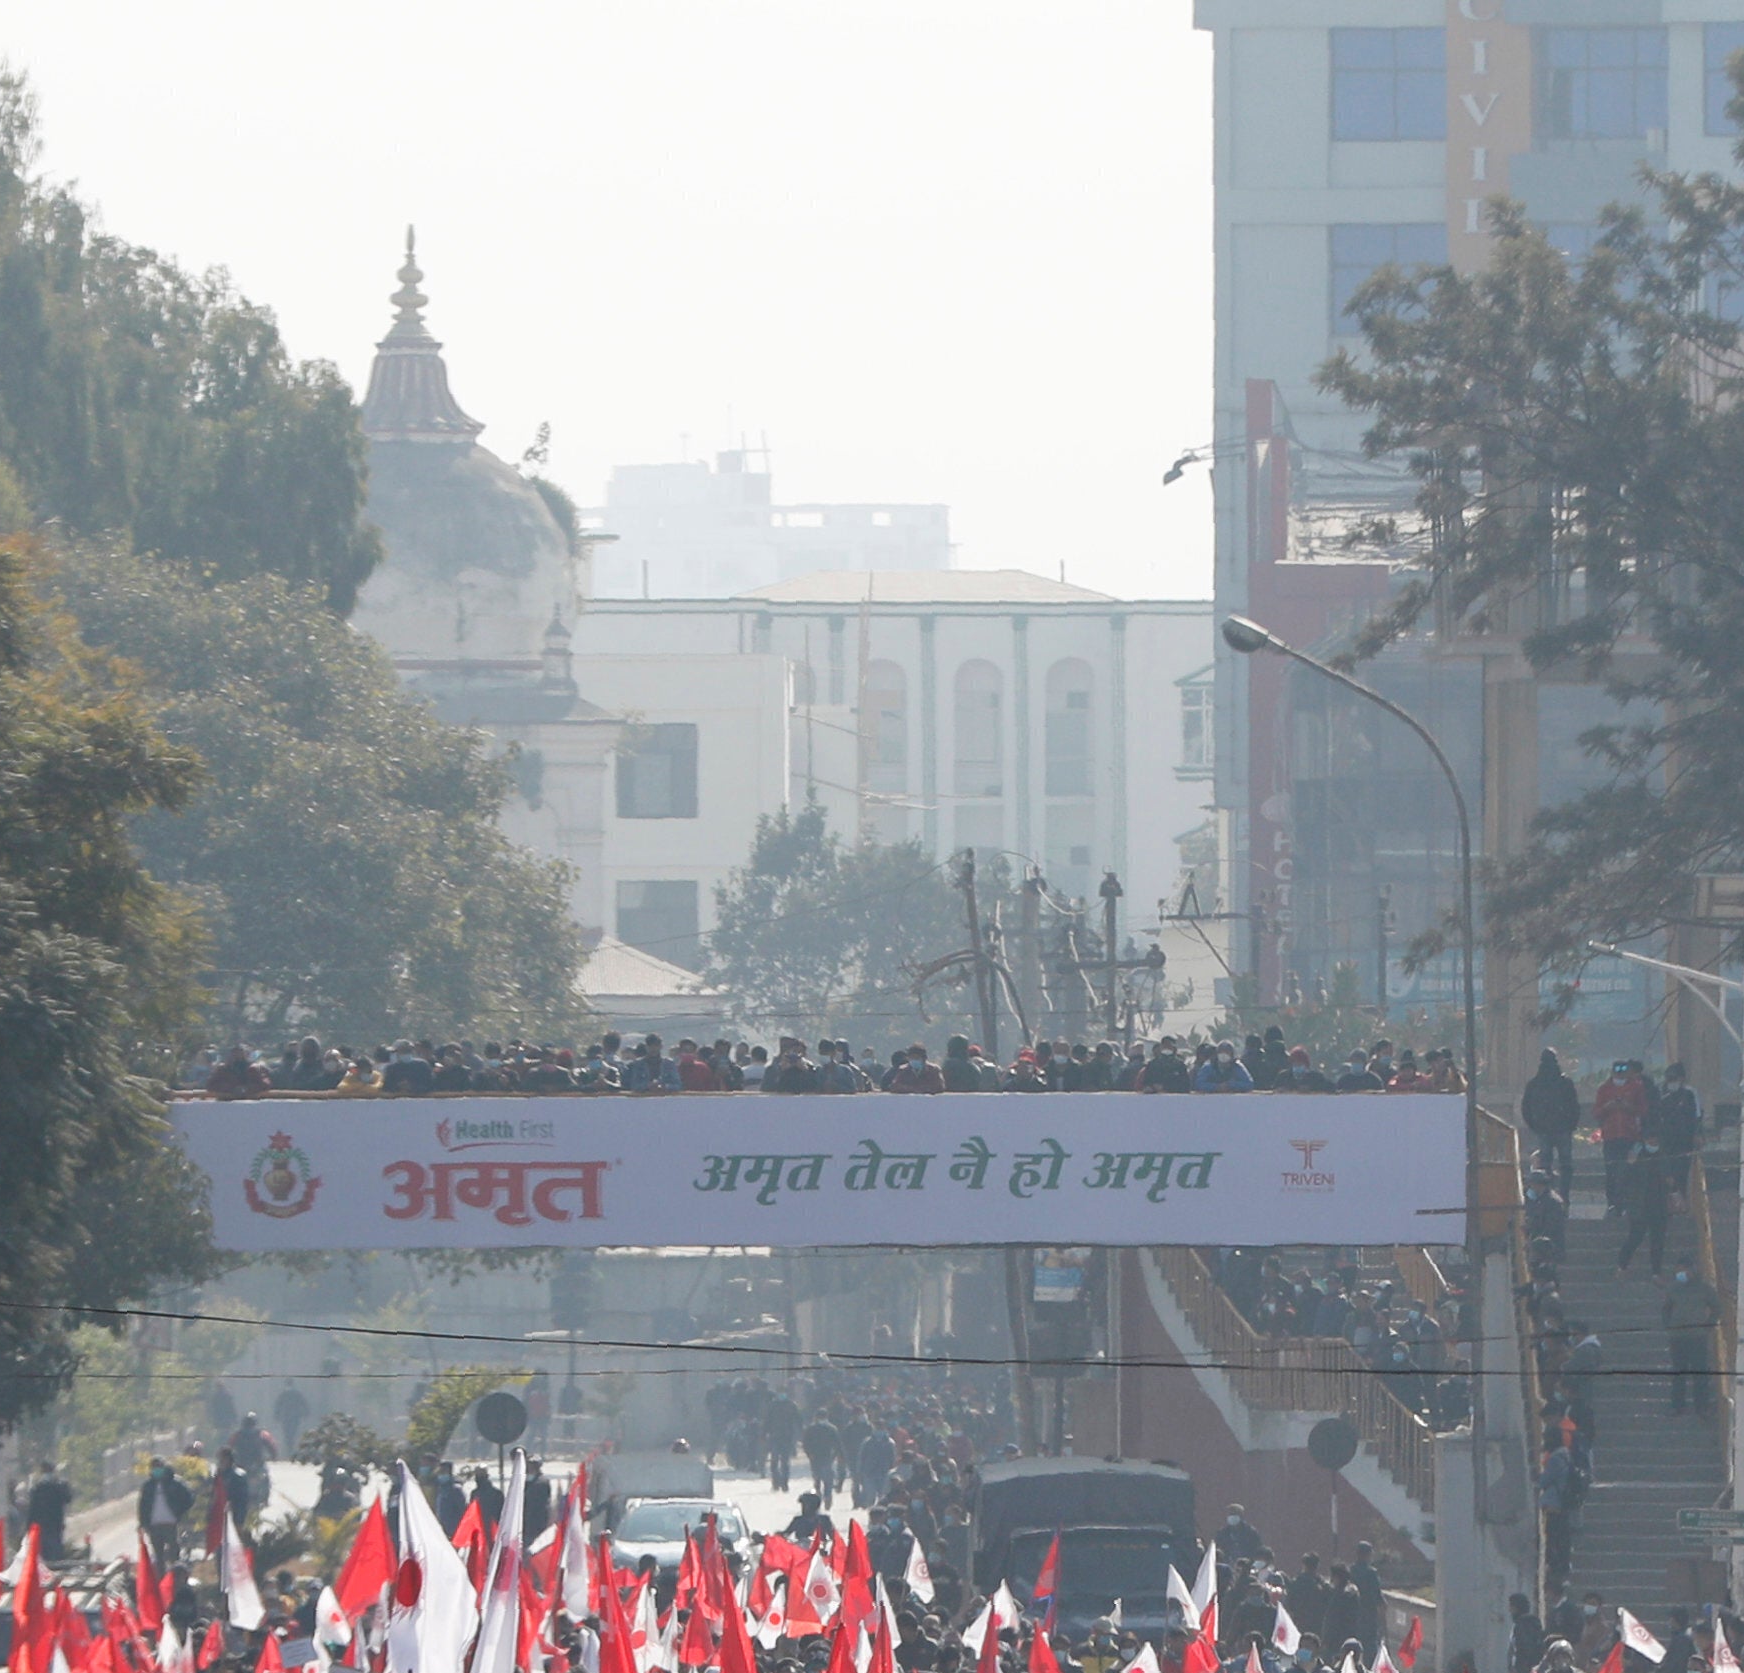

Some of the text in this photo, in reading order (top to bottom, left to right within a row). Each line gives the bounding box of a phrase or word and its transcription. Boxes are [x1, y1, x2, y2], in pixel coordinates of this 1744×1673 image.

[455, 1119, 555, 1139] Health First
[693, 1135, 1224, 1206] अमृत तेल नै हो अमृत
[1281, 1172, 1336, 1186] TRIVENI
[382, 1160, 608, 1226] अमृत
